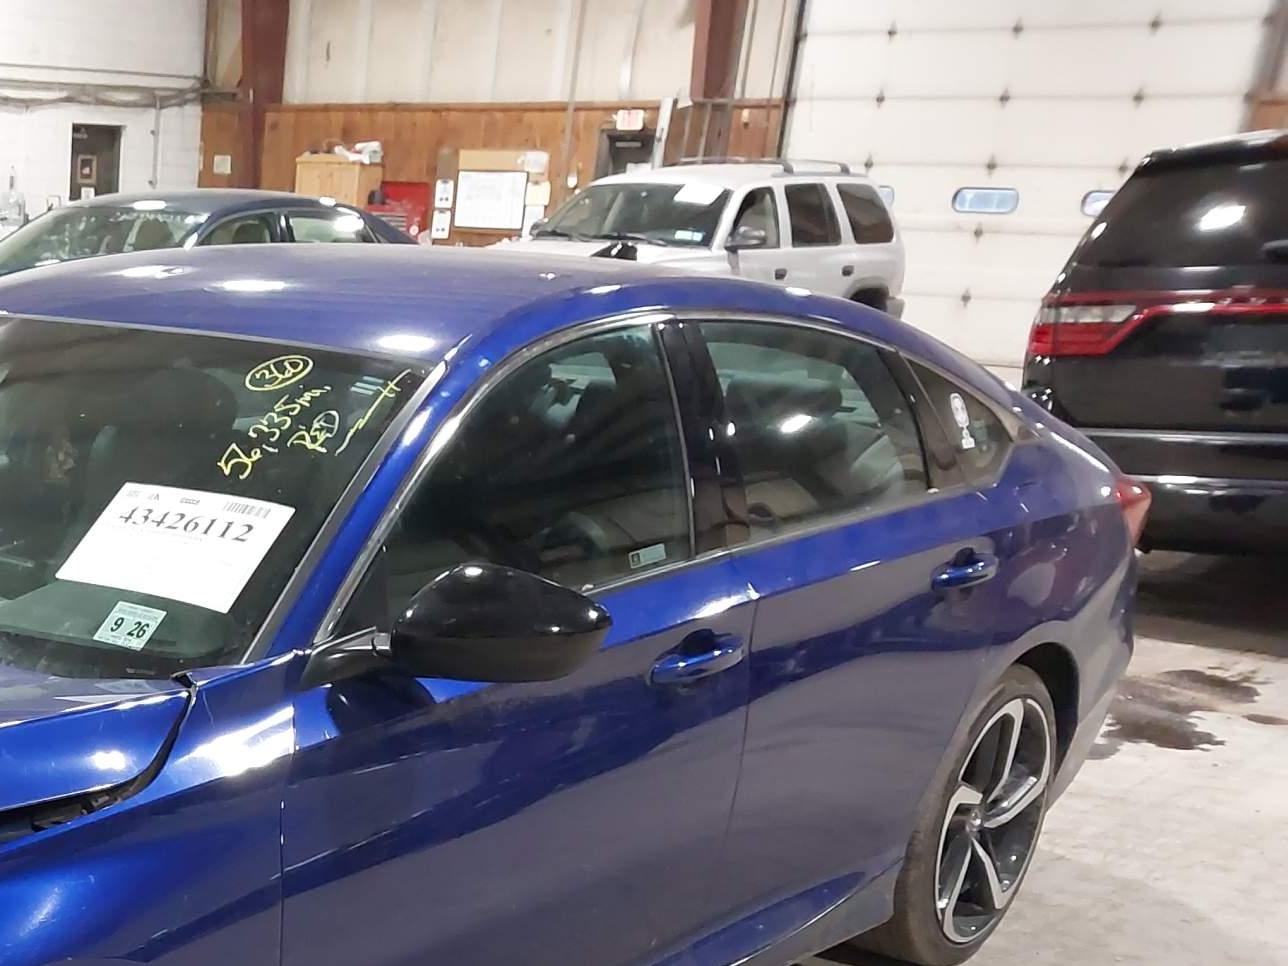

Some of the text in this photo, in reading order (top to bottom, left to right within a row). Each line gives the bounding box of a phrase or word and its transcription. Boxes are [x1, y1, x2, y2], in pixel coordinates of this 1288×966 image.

[255, 358, 304, 388] 360
[119, 506, 254, 543] 43426112
[110, 616, 150, 639] 9 26
